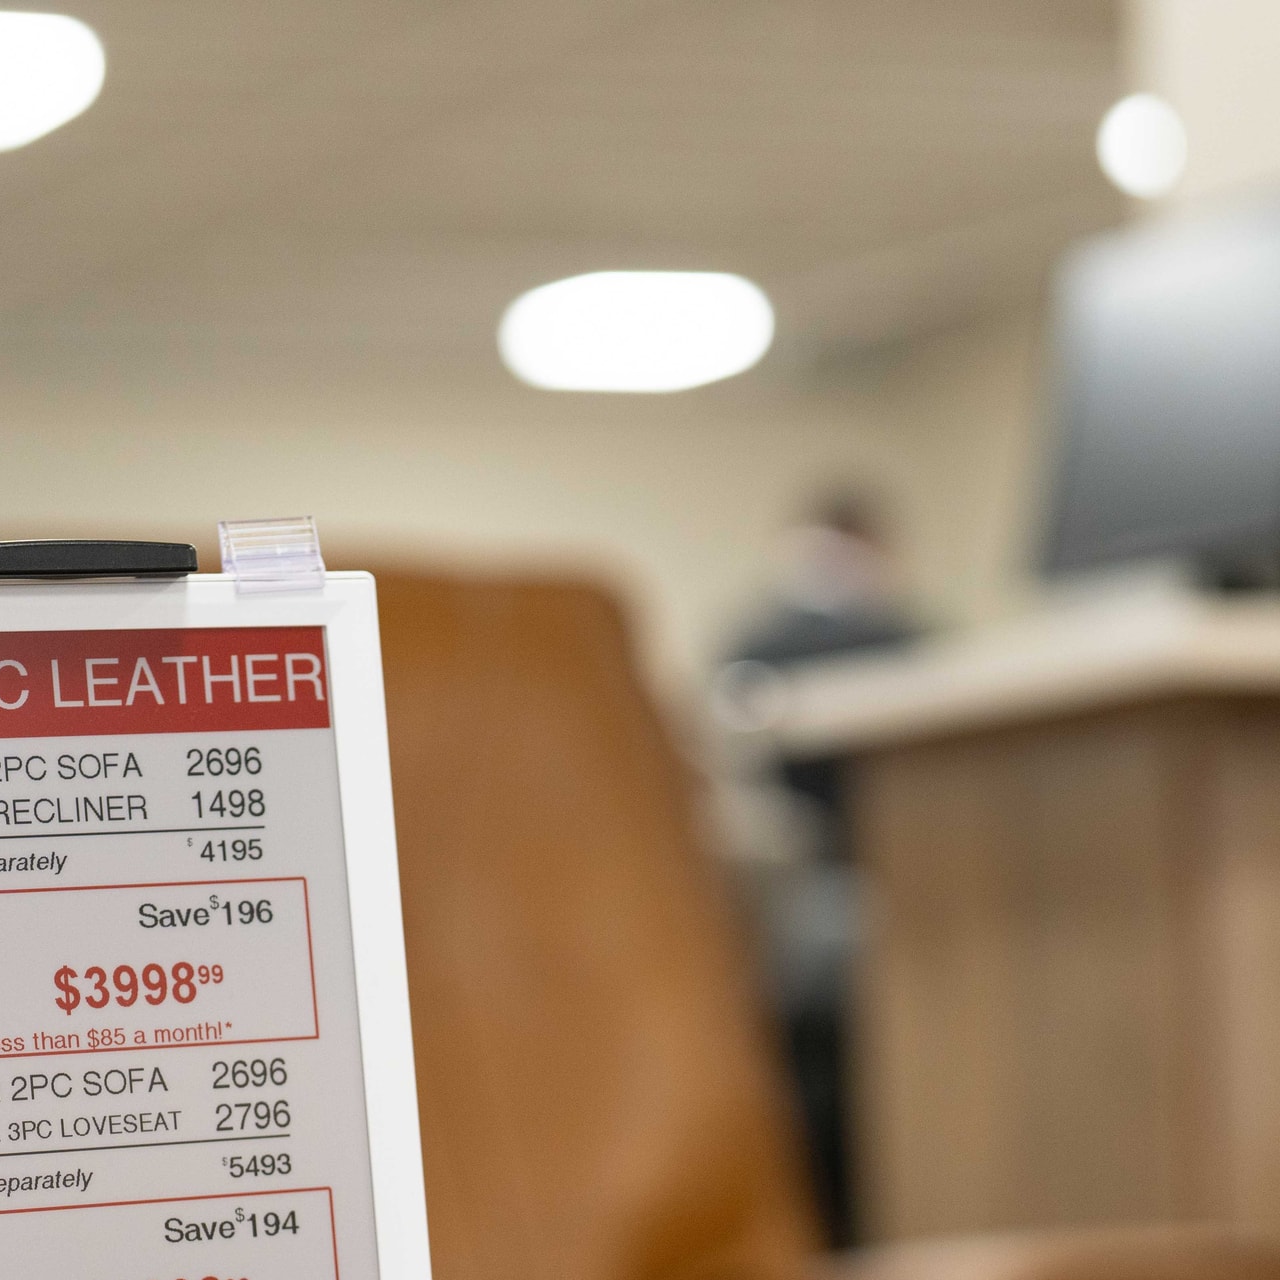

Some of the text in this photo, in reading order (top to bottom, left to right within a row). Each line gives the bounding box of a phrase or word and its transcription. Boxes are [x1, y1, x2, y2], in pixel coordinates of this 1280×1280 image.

[52, 653, 324, 707] LEATHER
[58, 753, 142, 779] SOFA
[187, 747, 261, 776] 2696
[192, 789, 265, 818] 1498
[33, 1032, 79, 1050] than
[86, 1028, 126, 1051] $85
[133, 1032, 147, 1046] a
[12, 1073, 72, 1101] 2PC
[84, 1067, 168, 1096] SOFA
[213, 1058, 287, 1089] 2696
[8, 1120, 52, 1141] 3PC
[61, 1111, 181, 1137] LOVESEAT
[216, 1100, 290, 1131] 2796
